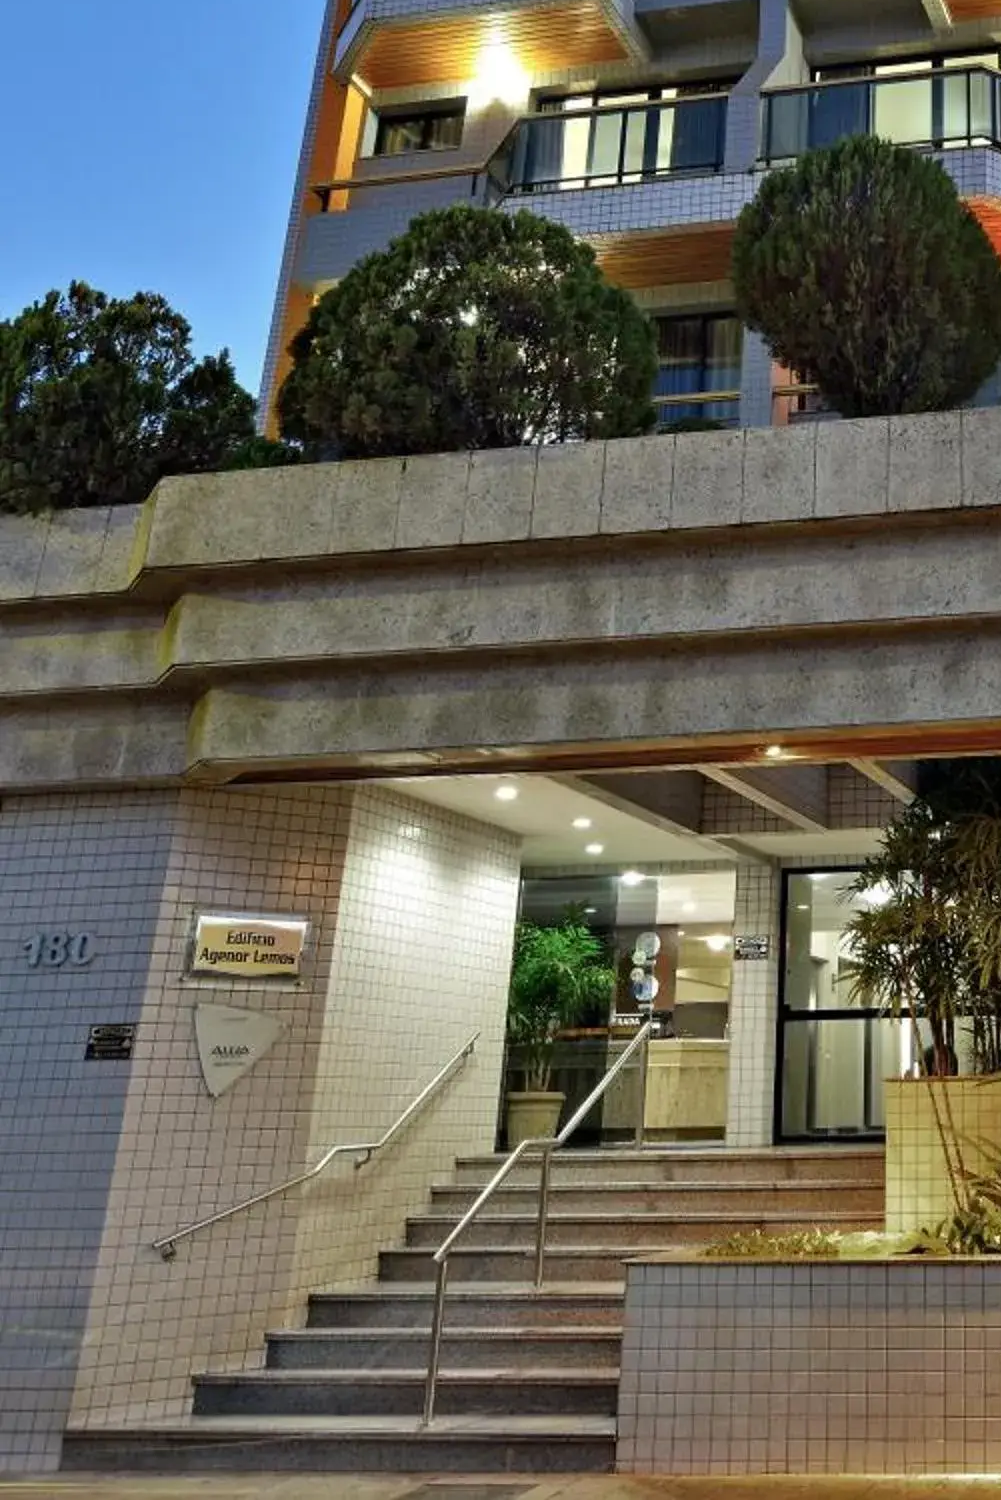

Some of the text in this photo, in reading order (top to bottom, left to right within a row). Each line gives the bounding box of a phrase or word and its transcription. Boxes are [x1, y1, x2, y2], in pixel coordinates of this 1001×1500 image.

[23, 930, 97, 969] 180
[199, 947, 295, 965] Agenor Lemos
